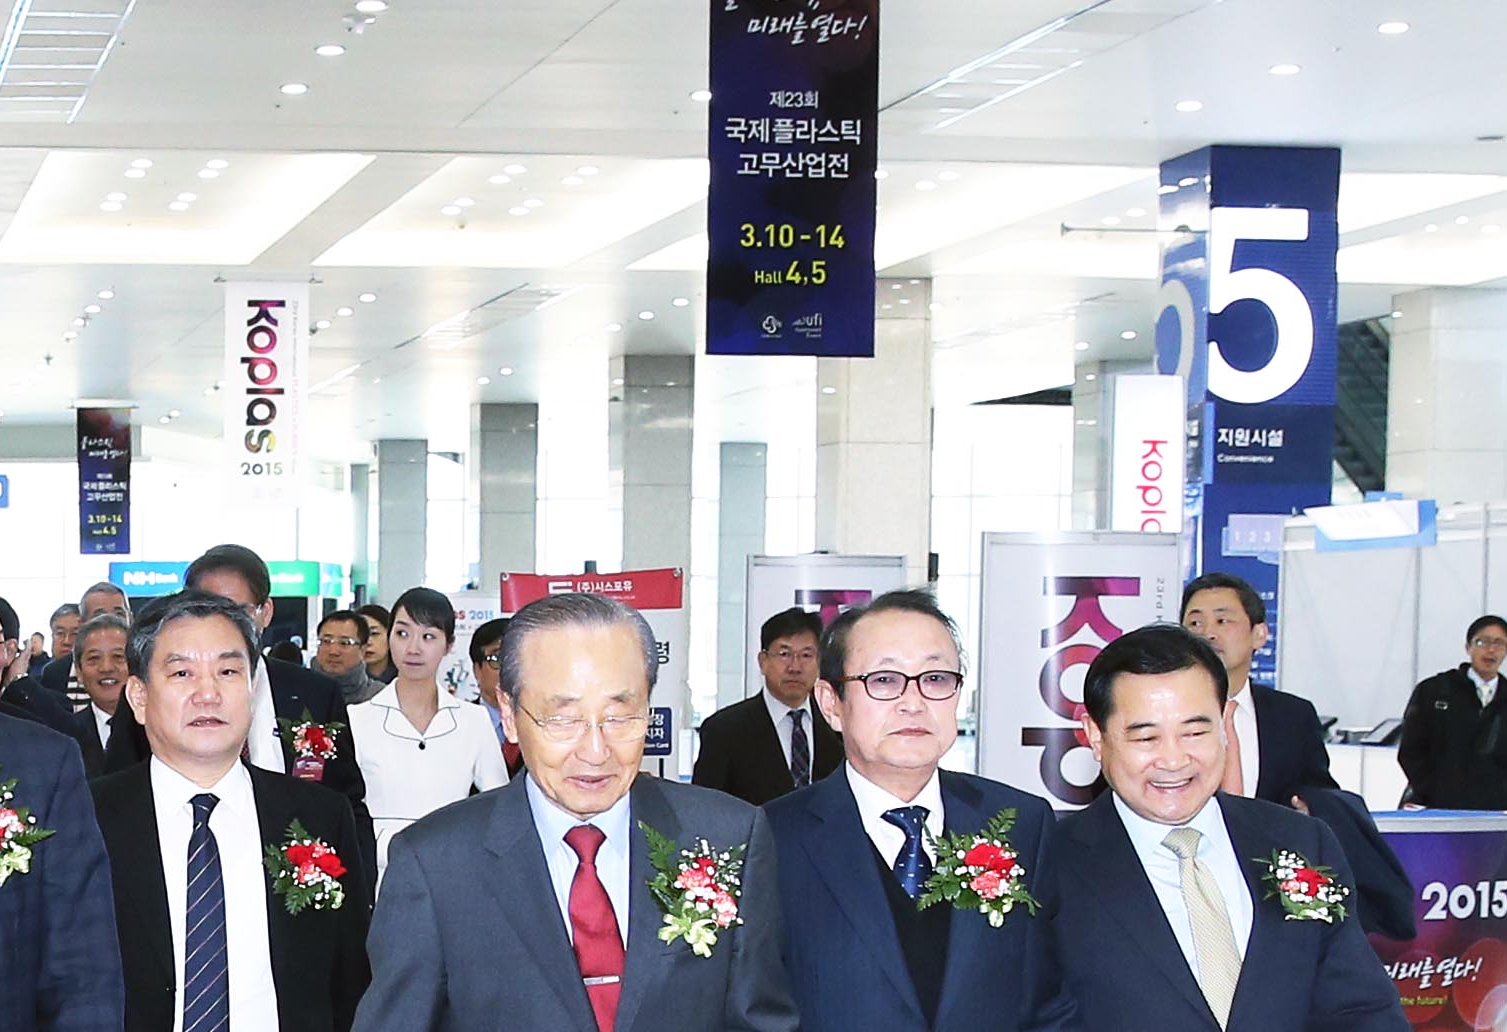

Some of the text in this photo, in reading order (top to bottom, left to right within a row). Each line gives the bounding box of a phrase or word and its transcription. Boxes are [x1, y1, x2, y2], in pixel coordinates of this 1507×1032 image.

[768, 90, 819, 109] 제23회
[736, 152, 850, 179] 고무산업전
[754, 270, 783, 284] Hall
[1206, 206, 1315, 405] 5
[1217, 427, 1284, 448] 지원시설
[240, 462, 283, 476] 2015
[1421, 881, 1507, 920] 2015
